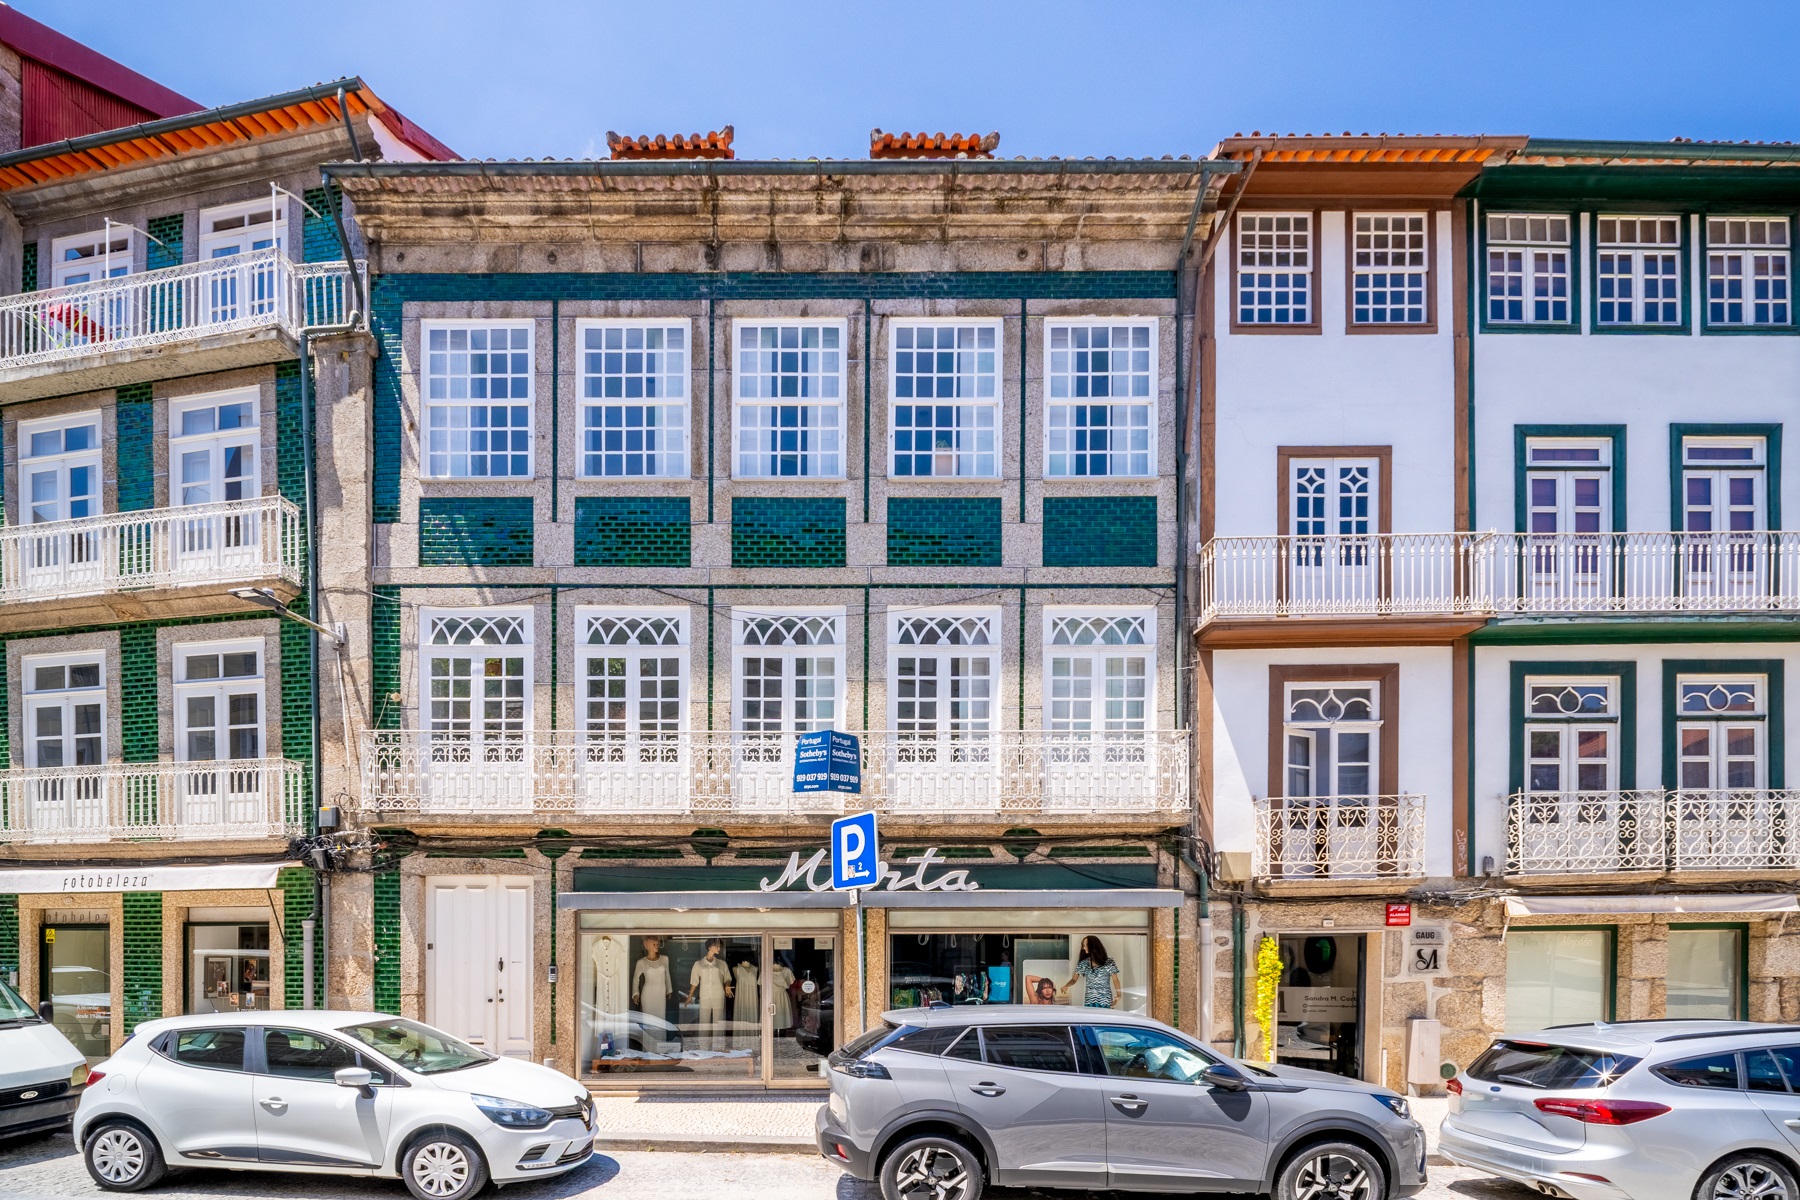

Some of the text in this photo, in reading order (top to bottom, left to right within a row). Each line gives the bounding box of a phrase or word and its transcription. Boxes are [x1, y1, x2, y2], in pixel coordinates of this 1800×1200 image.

[802, 736, 821, 745] Portugal
[832, 736, 851, 746] Portugal
[800, 749, 827, 757] Sotheby's
[832, 749, 857, 760] Sotheby's
[806, 773, 816, 781] 037
[840, 774, 849, 782] 037
[840, 823, 866, 882] P
[759, 847, 980, 892] Mrta
[857, 861, 864, 871] 2
[62, 873, 148, 891] fotobeleza
[1415, 931, 1435, 940] GAUG
